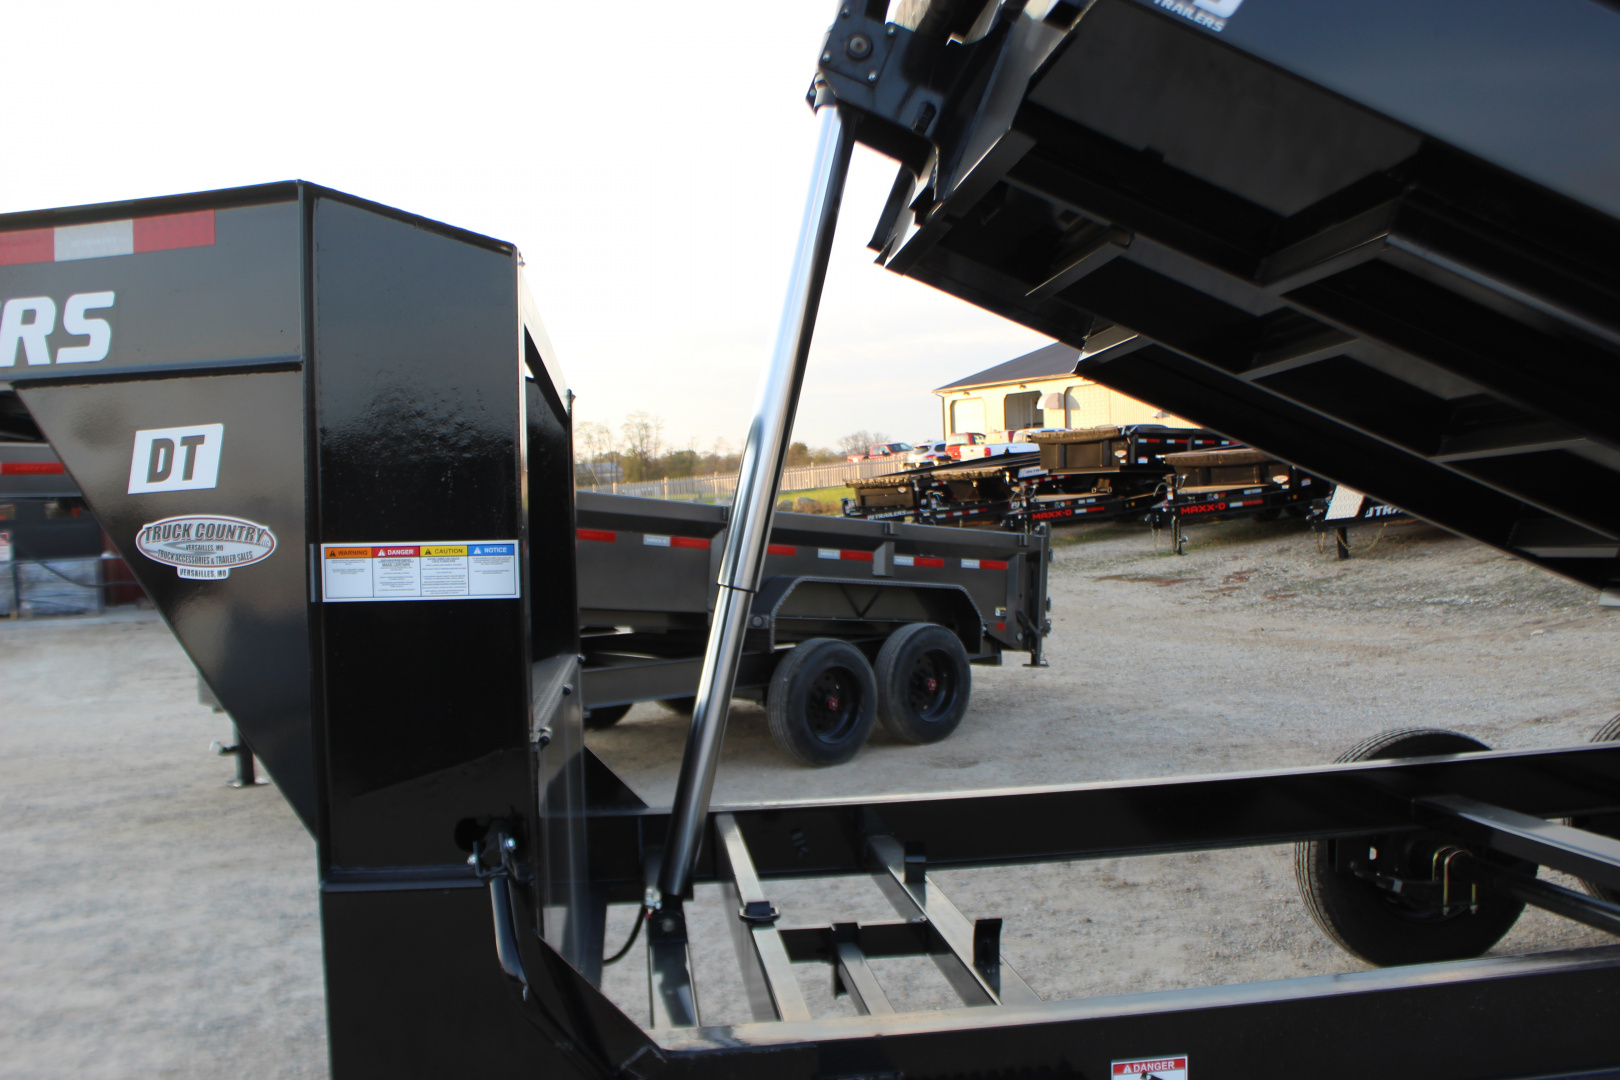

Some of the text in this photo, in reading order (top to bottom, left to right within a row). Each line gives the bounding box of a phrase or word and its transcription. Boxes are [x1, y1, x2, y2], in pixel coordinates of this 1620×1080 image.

[146, 434, 206, 484] DT
[1032, 509, 1073, 520] MAXX-D
[1181, 502, 1227, 515] MAXX-D
[145, 523, 193, 544] TRUCK
[195, 523, 268, 545] COUNTRY
[157, 549, 175, 560] TRUCK
[174, 553, 210, 565] ACCESSORIES
[215, 555, 237, 565] TRAILER
[237, 551, 253, 563] SALES
[217, 569, 227, 578] MO
[1133, 1060, 1175, 1073] DANGER
